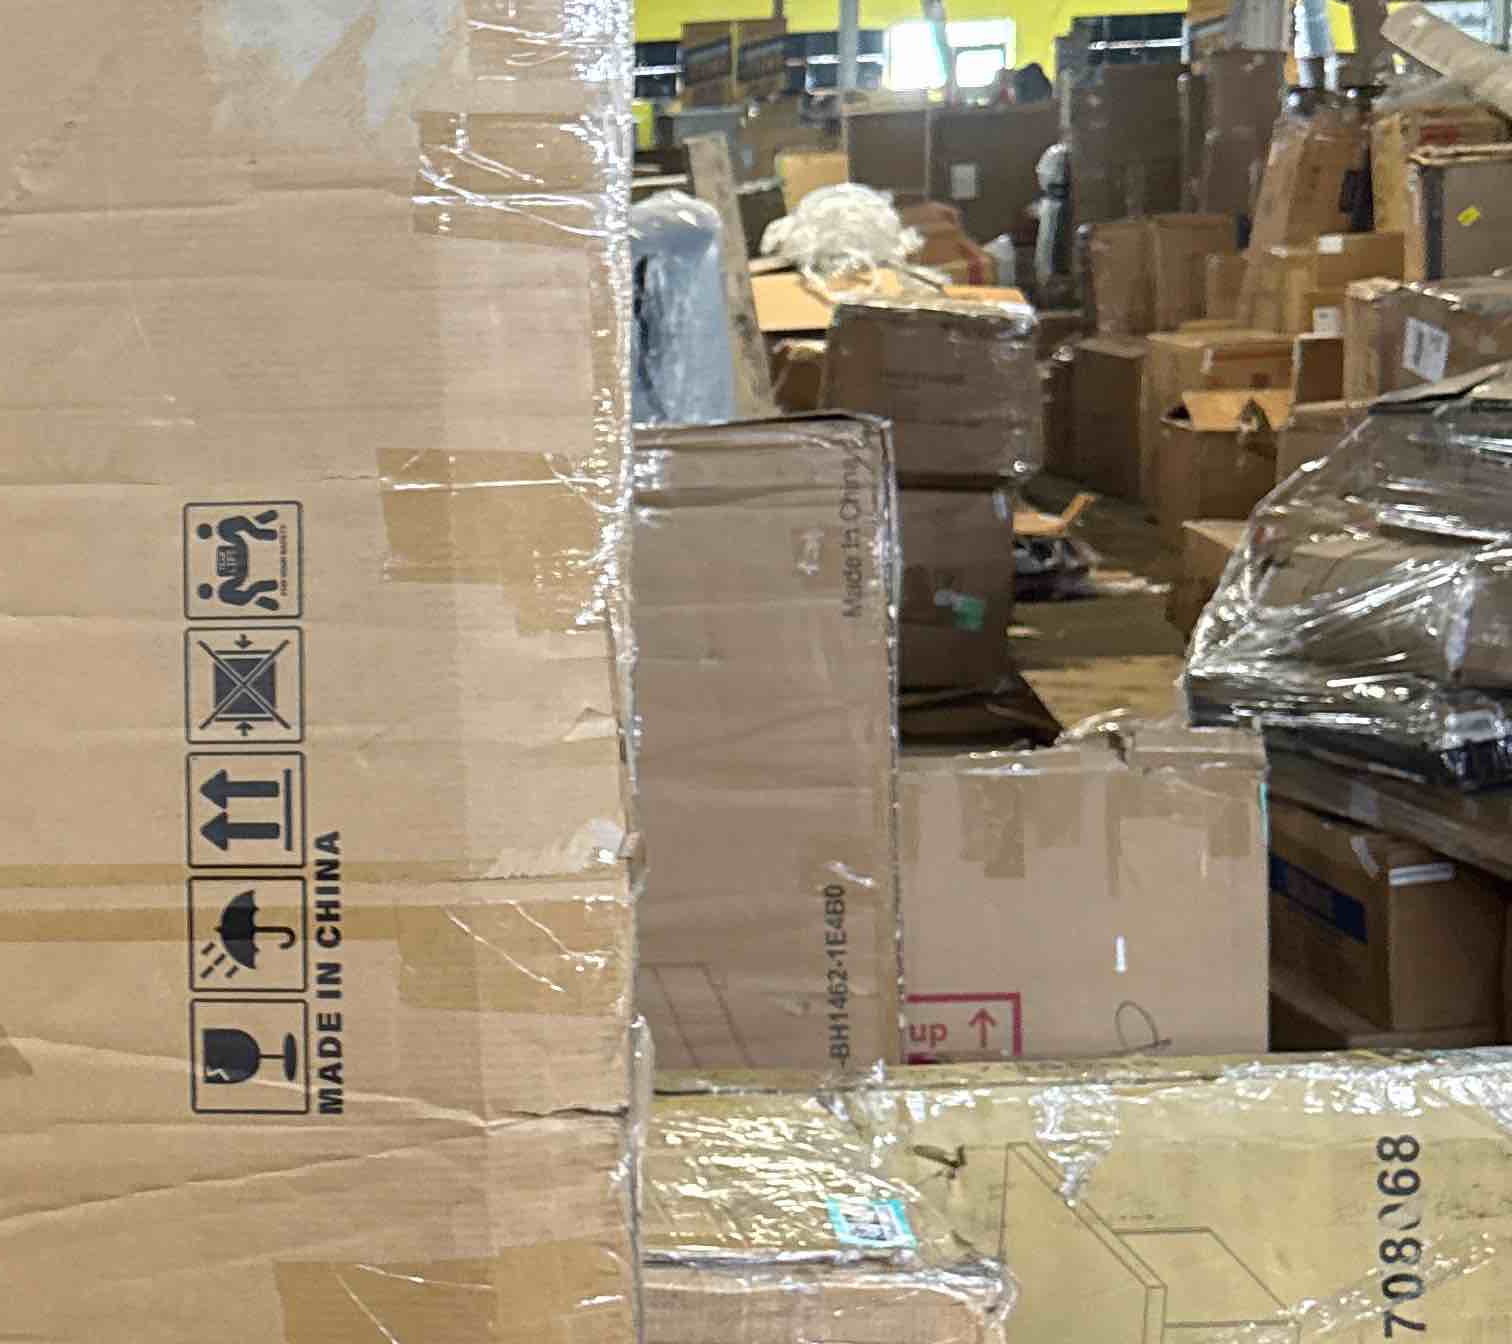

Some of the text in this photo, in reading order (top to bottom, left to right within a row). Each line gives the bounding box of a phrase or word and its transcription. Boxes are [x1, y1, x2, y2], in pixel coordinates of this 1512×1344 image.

[313, 831, 344, 1115] MADE IN CHINA
[909, 1022, 948, 1047] up
